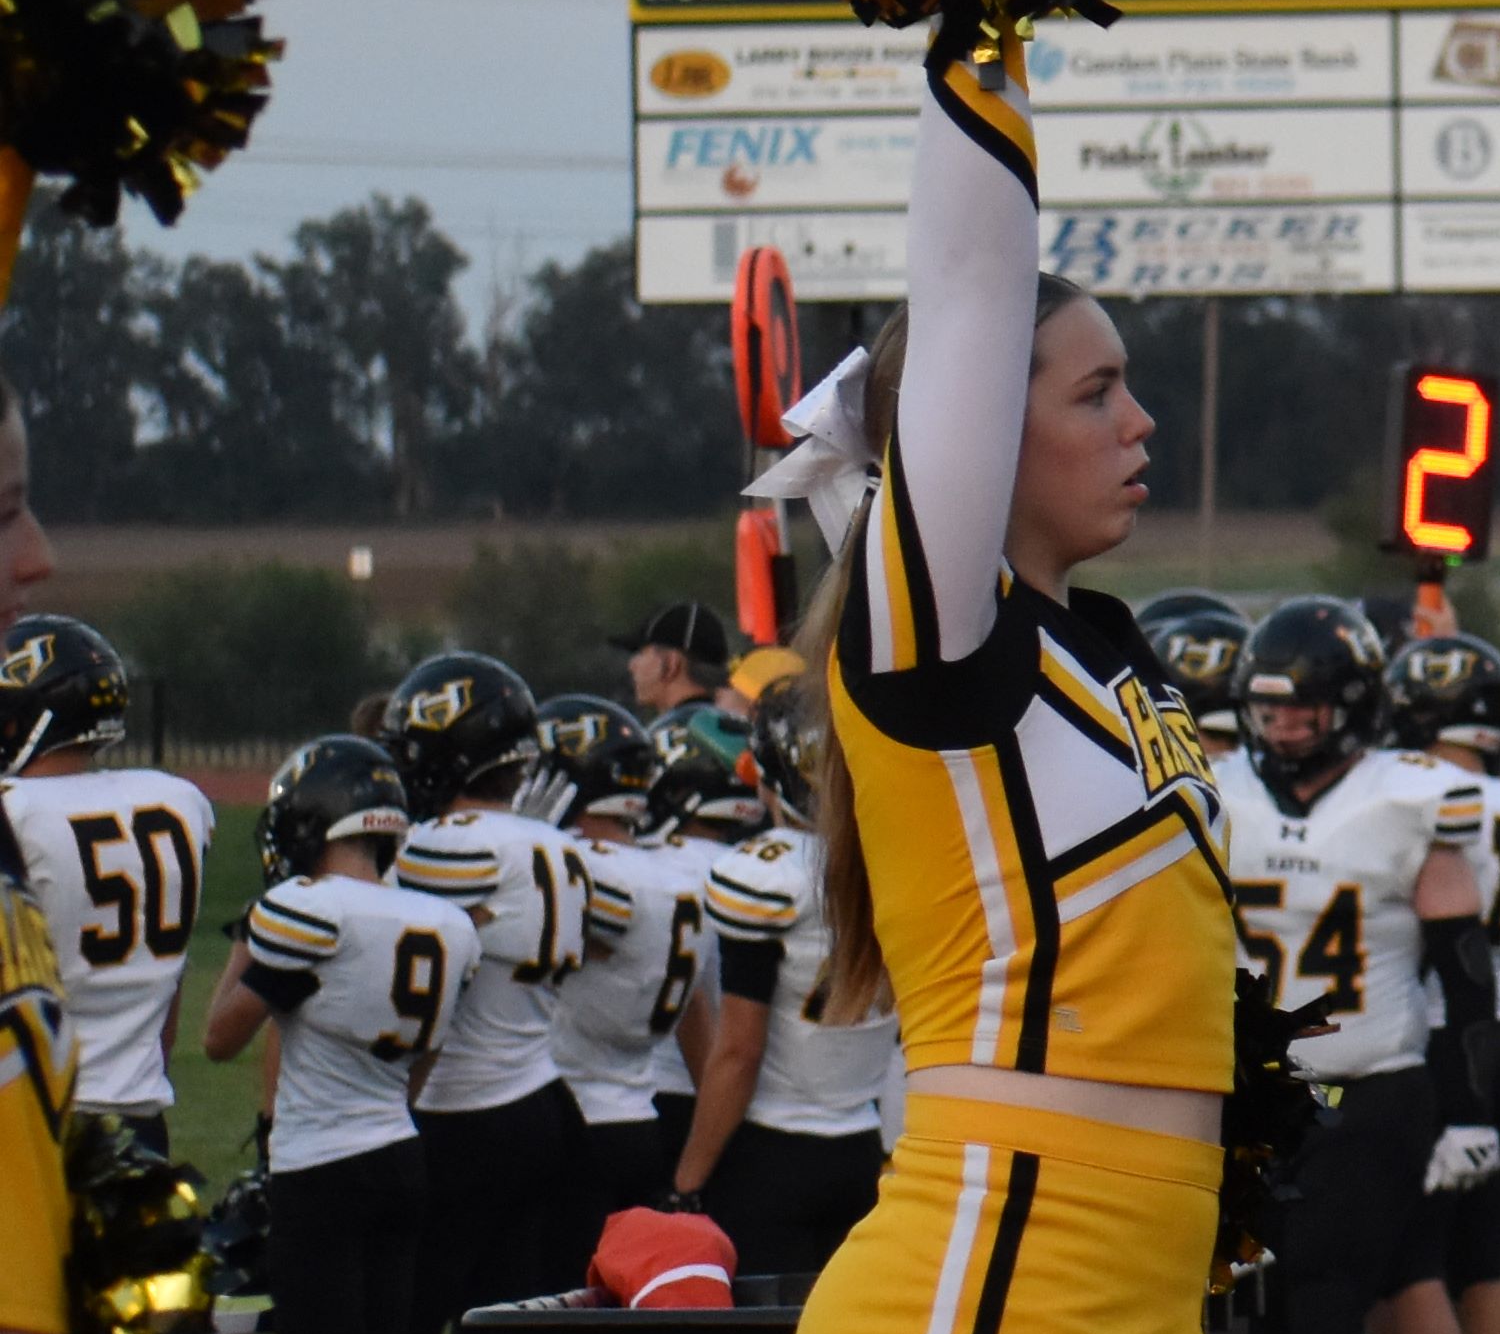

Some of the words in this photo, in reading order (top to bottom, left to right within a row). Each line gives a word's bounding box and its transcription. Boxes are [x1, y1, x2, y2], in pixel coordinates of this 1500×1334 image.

[666, 125, 823, 168] FENIX
[1403, 375, 1490, 553] 2
[67, 802, 200, 966] 50
[1228, 879, 1369, 1013] 54
[369, 927, 447, 1063] 9
